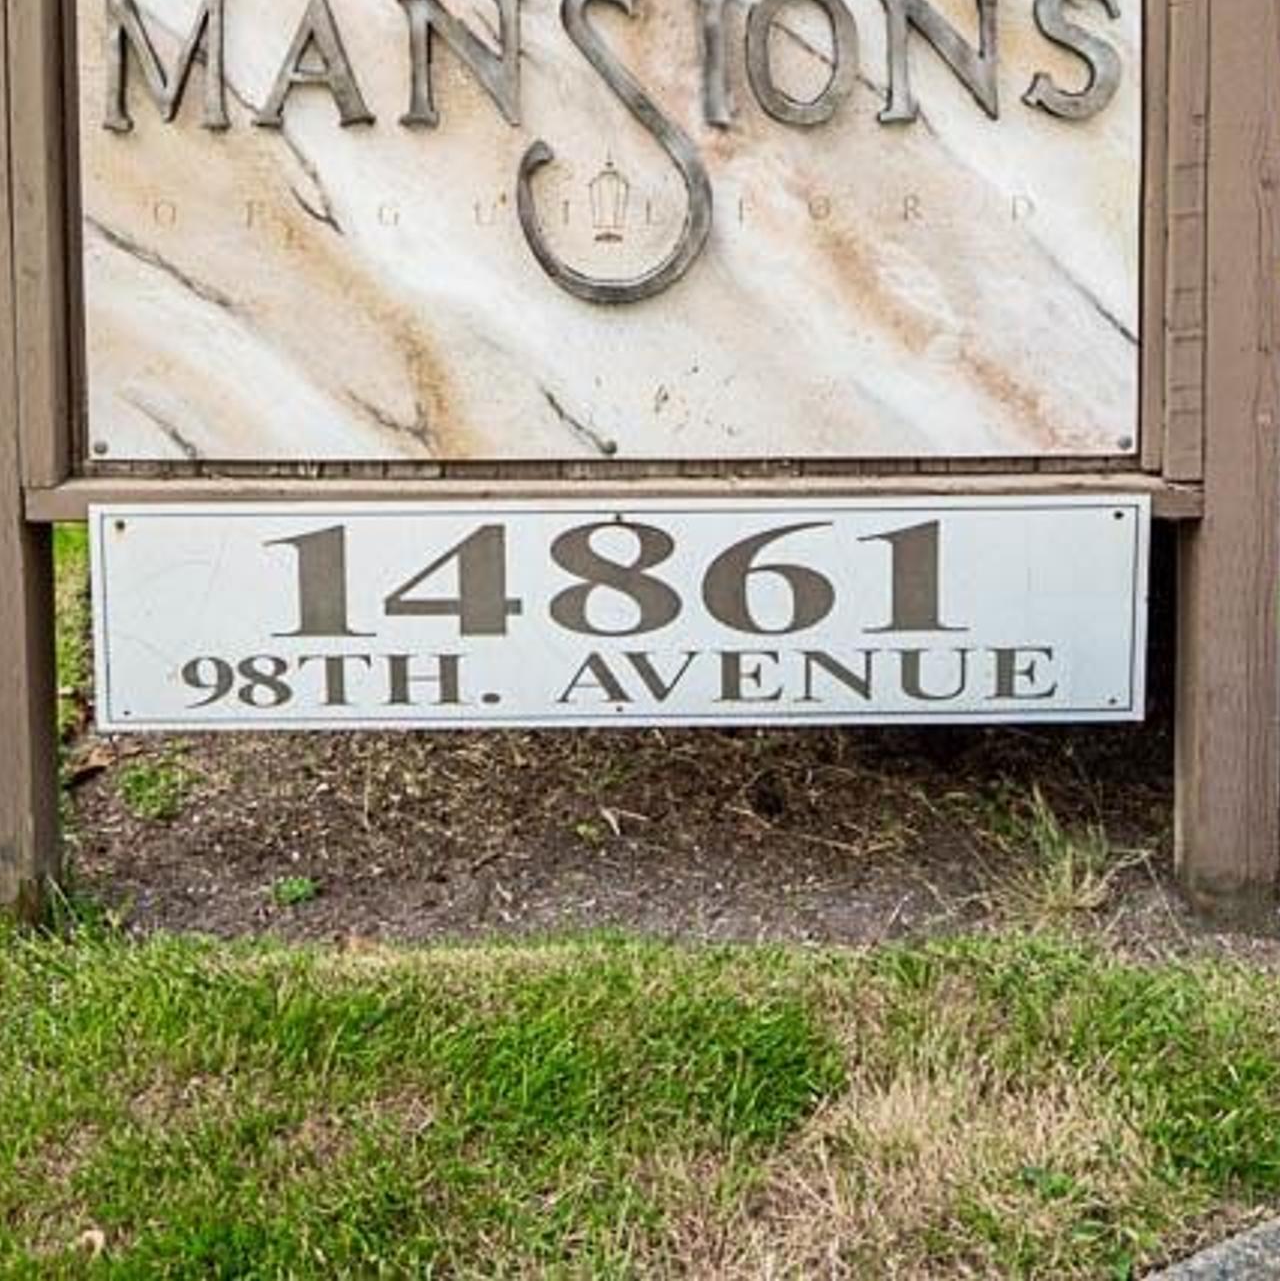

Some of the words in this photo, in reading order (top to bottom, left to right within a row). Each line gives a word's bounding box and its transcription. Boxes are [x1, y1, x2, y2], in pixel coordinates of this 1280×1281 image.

[262, 519, 970, 639] 14861
[181, 652, 502, 709] 98TH.
[554, 647, 1058, 704] AVENUE
